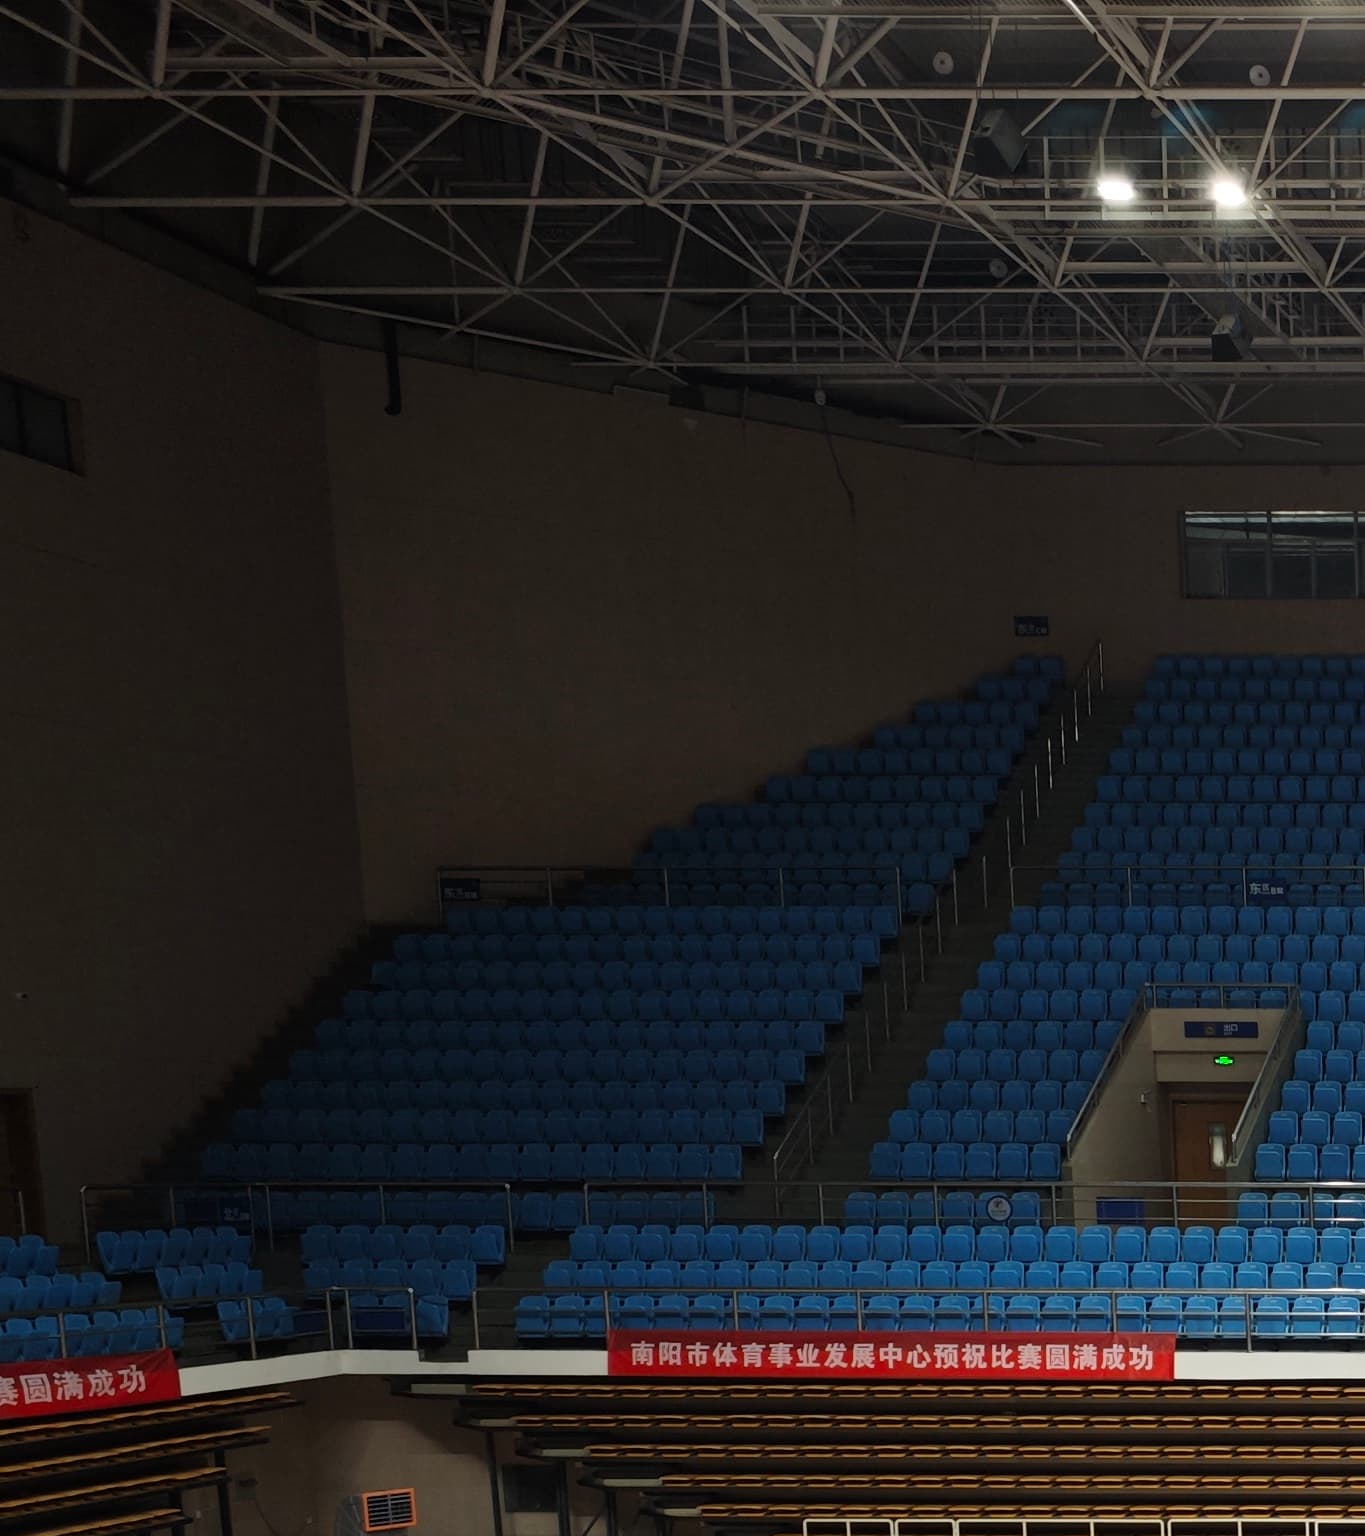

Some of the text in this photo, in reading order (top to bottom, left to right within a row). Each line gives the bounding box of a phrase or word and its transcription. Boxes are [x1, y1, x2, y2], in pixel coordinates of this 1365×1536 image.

[631, 1341, 1153, 1370] 南阳市体育事业发展中心预祝比赛圆满成功
